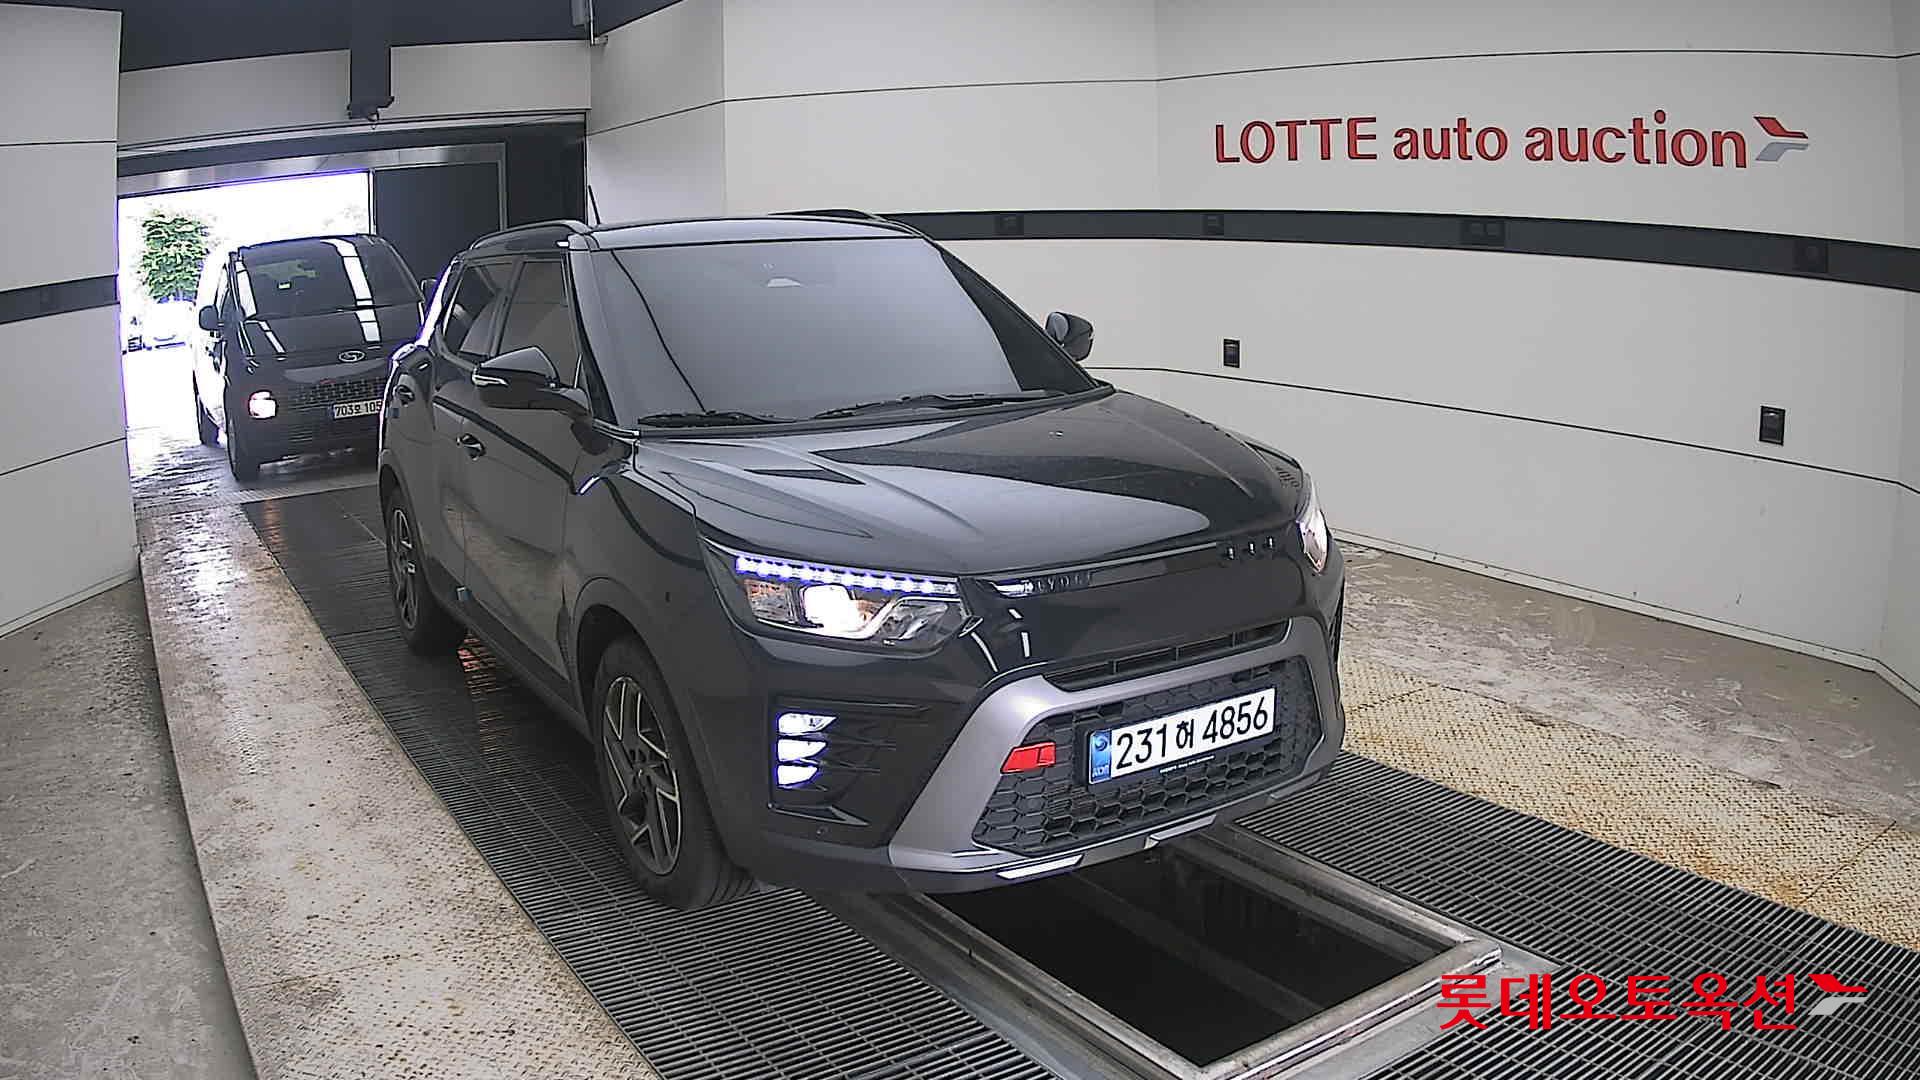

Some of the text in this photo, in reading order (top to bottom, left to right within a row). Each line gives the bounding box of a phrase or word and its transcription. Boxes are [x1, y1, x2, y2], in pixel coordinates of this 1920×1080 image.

[1216, 109, 1748, 169] LOTTE auto auction
[1202, 696, 1268, 744] 4856
